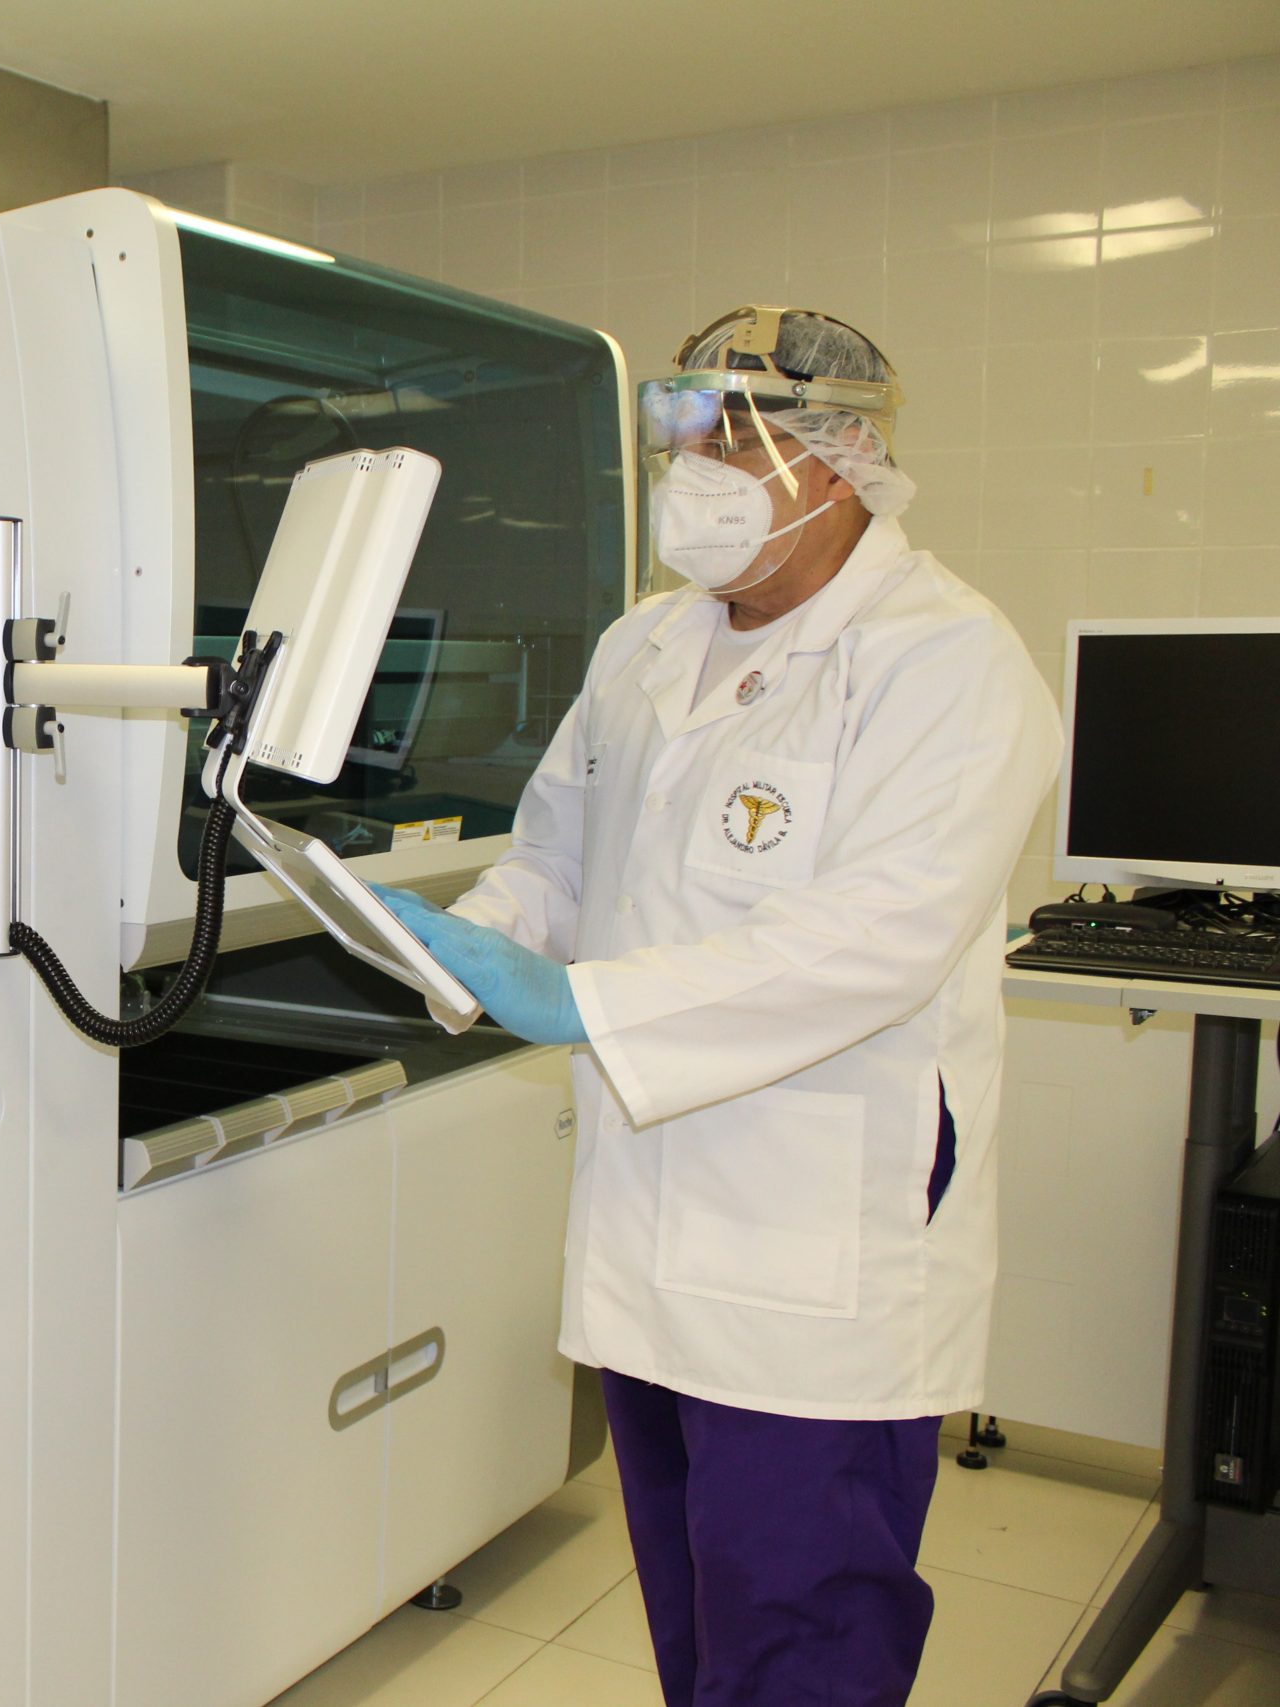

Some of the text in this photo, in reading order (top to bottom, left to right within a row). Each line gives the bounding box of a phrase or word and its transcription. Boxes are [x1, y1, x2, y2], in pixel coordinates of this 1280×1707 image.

[718, 516, 746, 525] KN95
[724, 780, 792, 824] HOSPITAL MILITAR ESCUELA
[723, 828, 754, 854] ALEJANDRO
